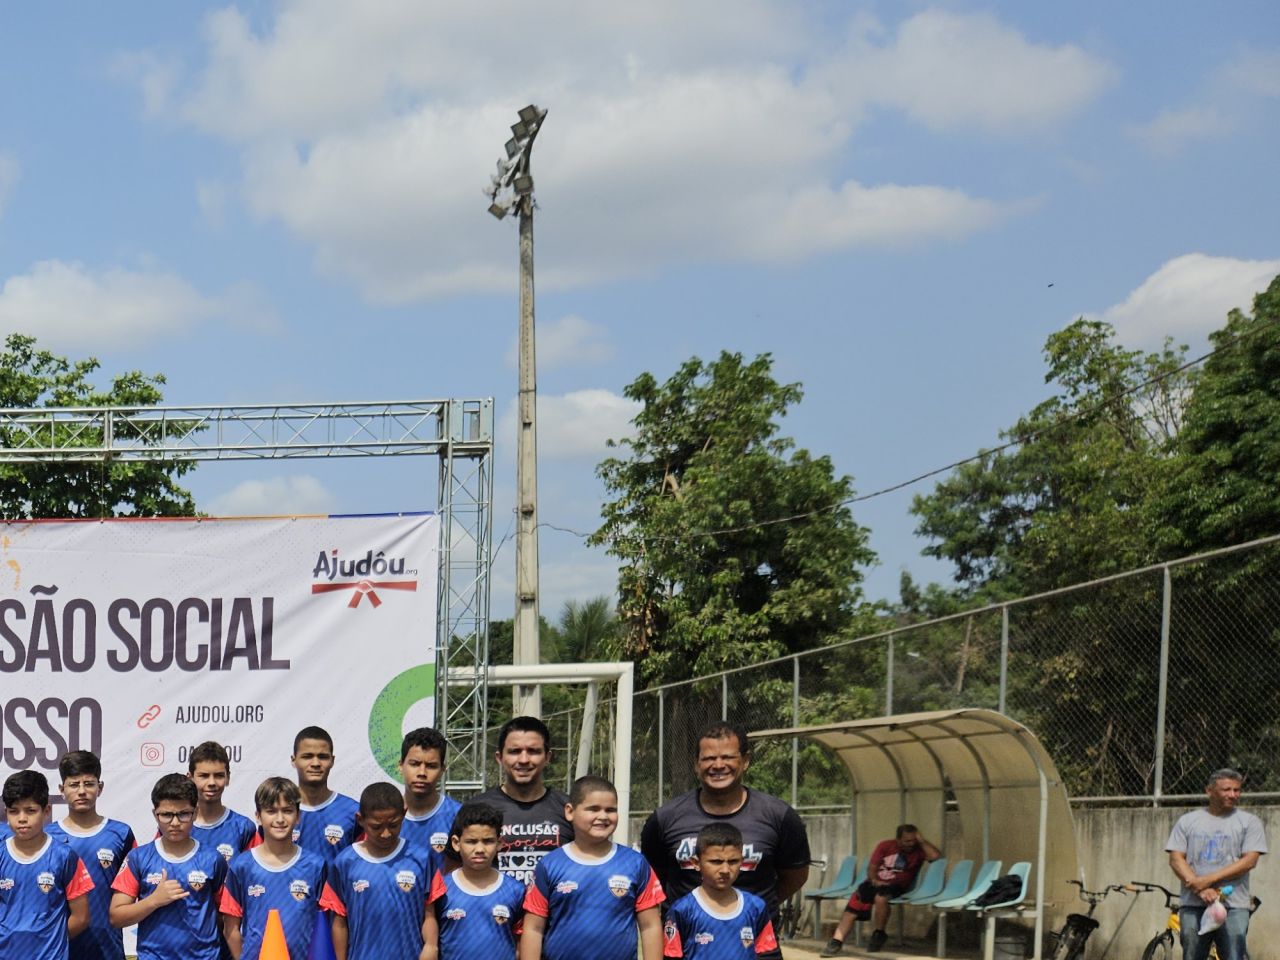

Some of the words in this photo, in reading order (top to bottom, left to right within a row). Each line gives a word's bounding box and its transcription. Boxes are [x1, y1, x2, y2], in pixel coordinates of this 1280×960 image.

[312, 549, 405, 581] Ajudôu
[106, 597, 291, 671] SOCIAL
[175, 705, 264, 724] AJUDOU.ORG
